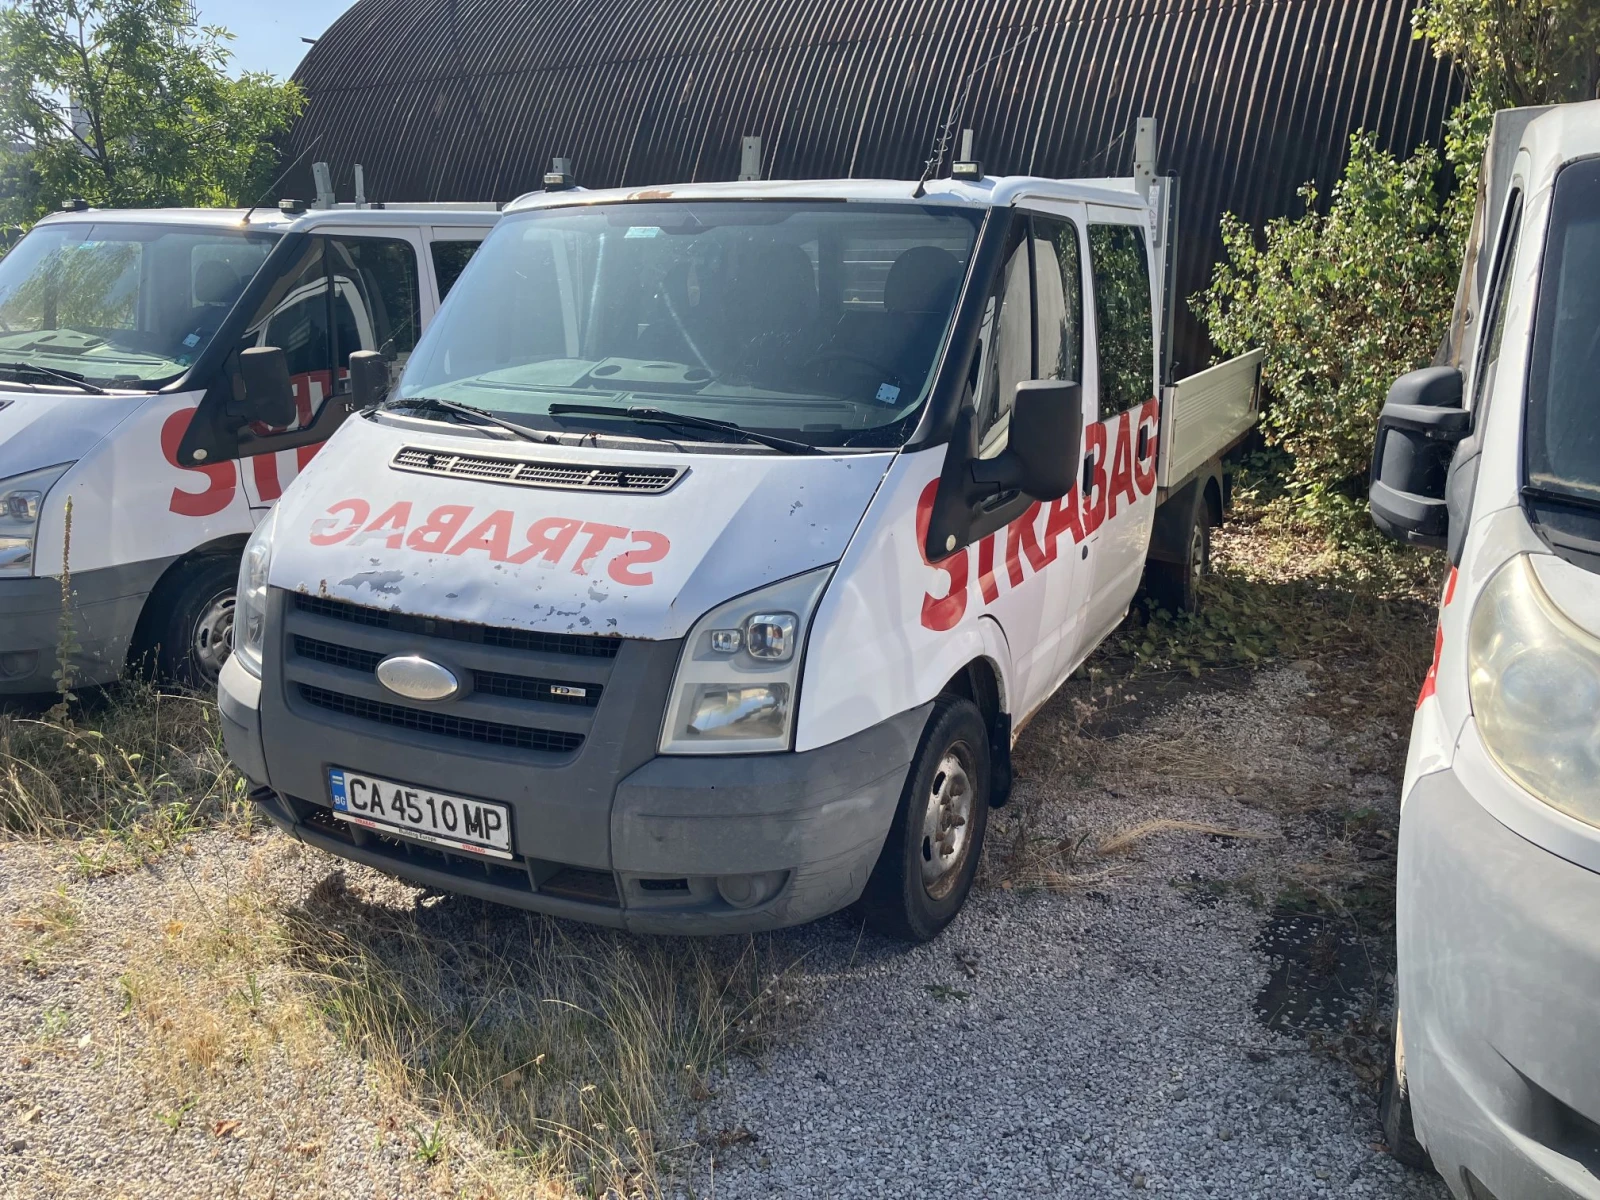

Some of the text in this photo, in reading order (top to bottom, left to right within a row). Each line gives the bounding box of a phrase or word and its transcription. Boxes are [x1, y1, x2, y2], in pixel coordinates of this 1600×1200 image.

[334, 795, 346, 806] BG
[349, 778, 502, 840] CA 4510 MP
